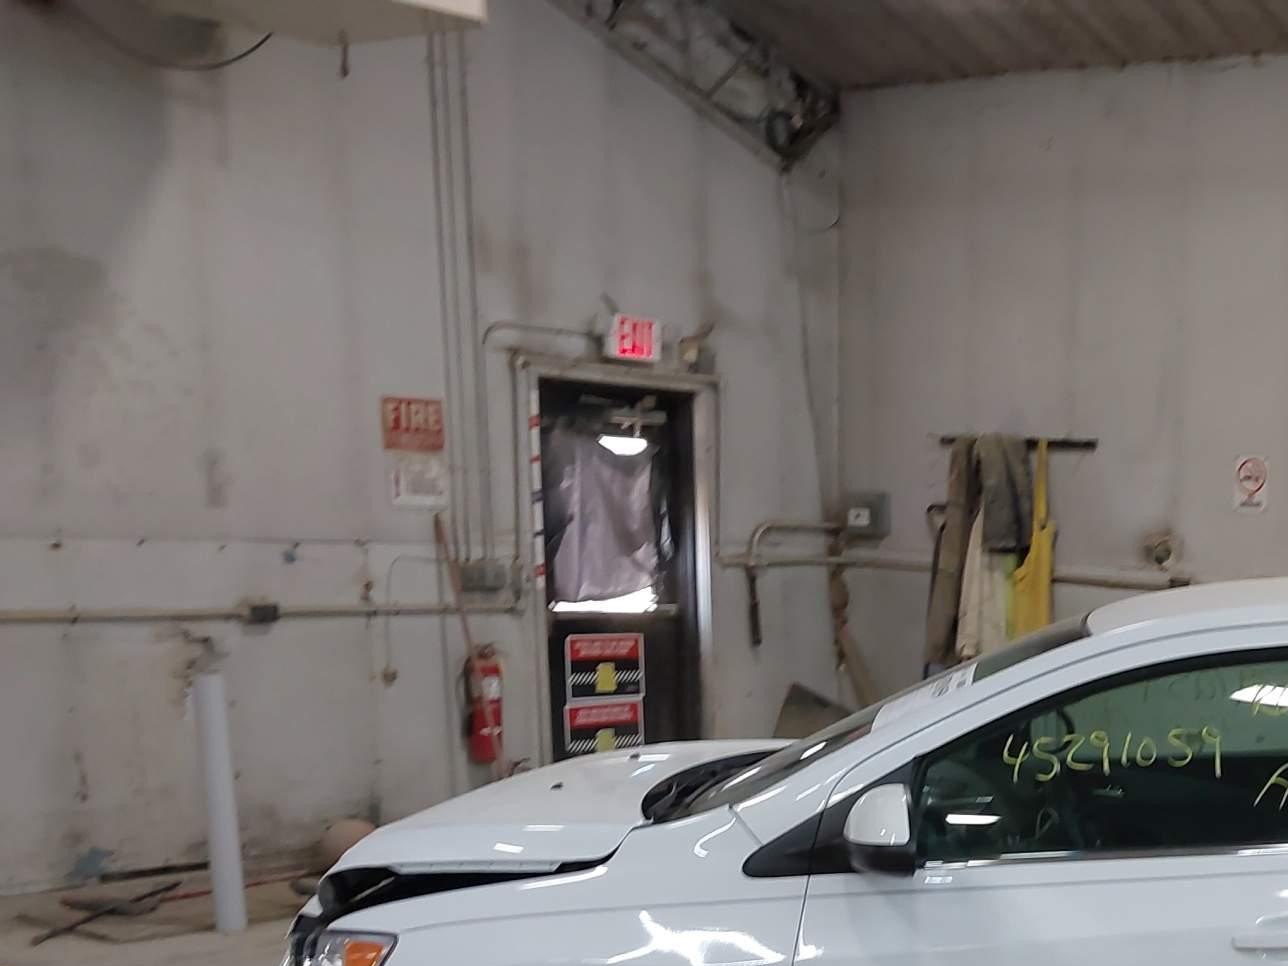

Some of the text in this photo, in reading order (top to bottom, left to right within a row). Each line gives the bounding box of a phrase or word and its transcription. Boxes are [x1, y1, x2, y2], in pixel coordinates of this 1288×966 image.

[619, 316, 654, 358] EXIT
[384, 401, 442, 431] FIRE
[1002, 725, 1223, 784] 45291059
